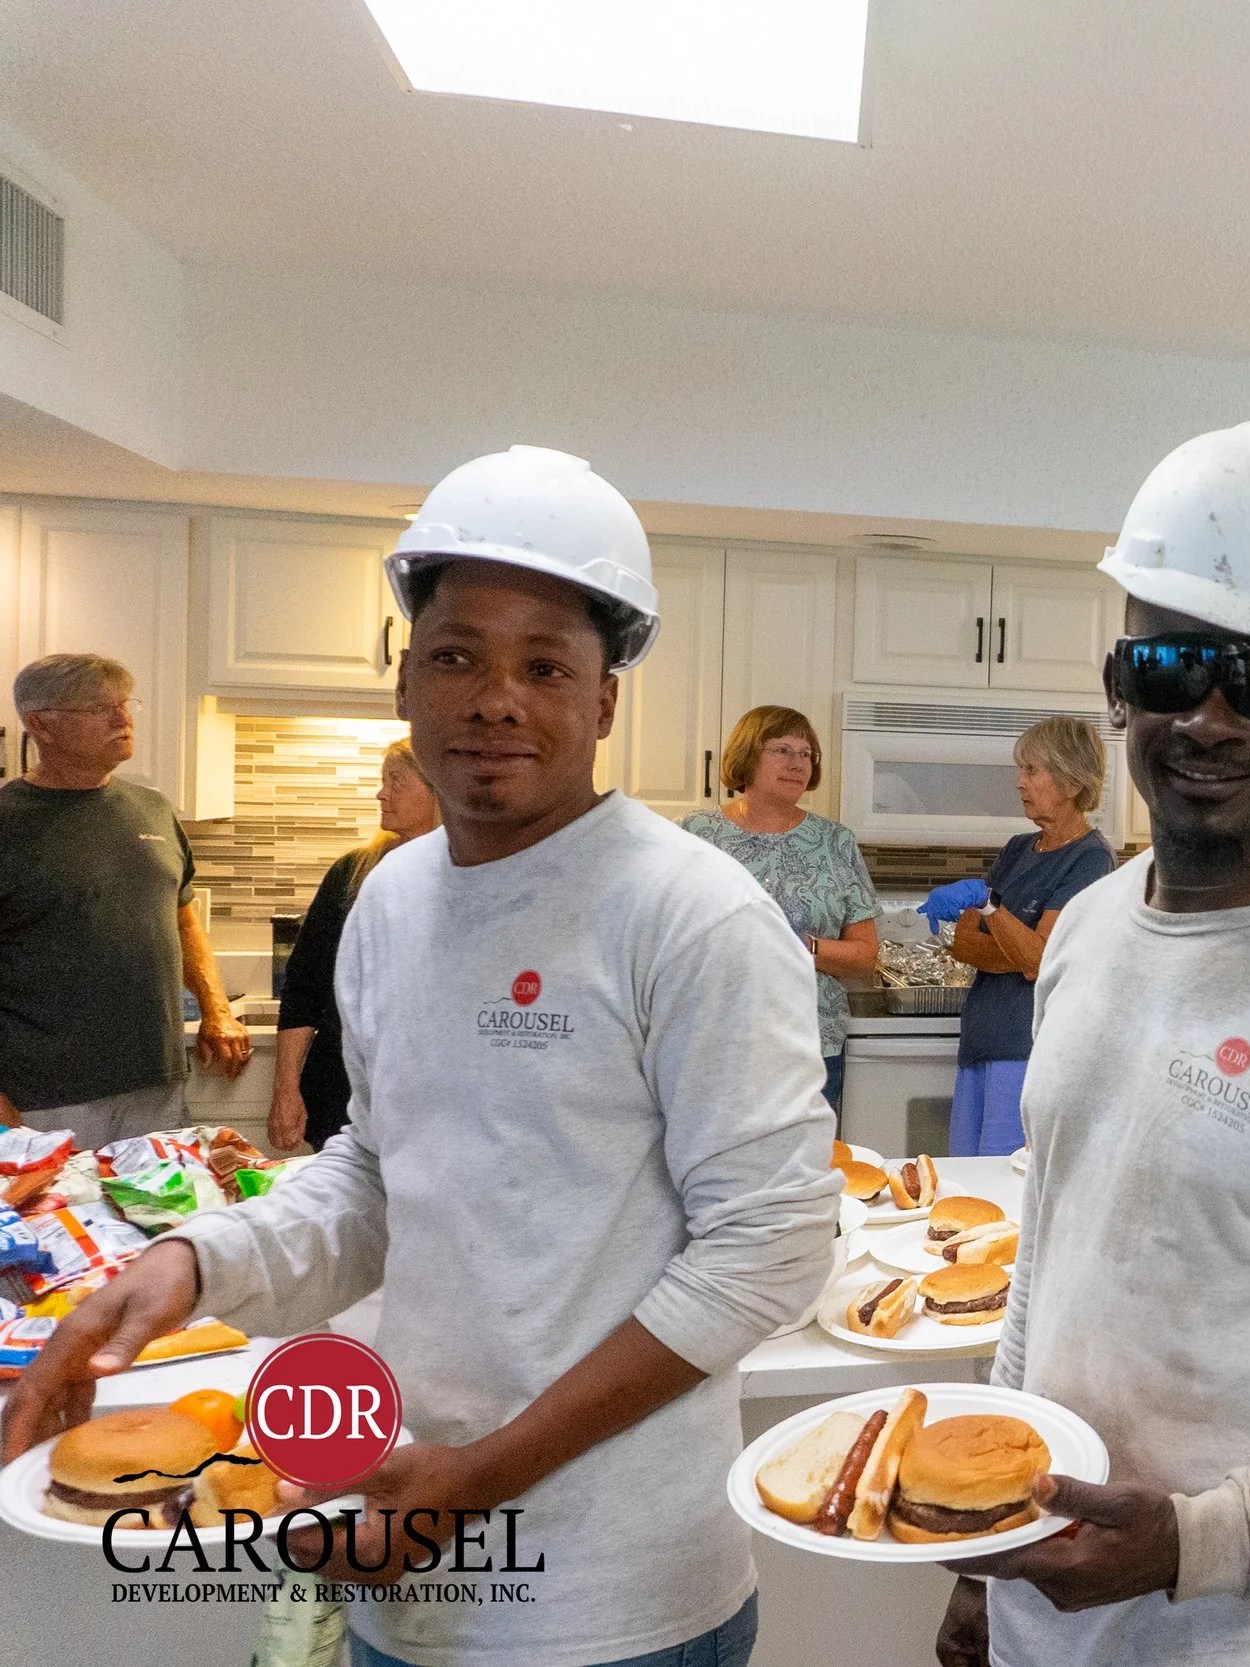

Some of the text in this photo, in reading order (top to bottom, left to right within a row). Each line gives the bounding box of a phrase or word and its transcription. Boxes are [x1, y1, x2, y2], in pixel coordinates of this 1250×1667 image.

[514, 981, 538, 995] CDR
[477, 1010, 575, 1033] CAROUSEL
[1219, 1046, 1248, 1068] CDR
[1207, 1107, 1245, 1133] 1524205
